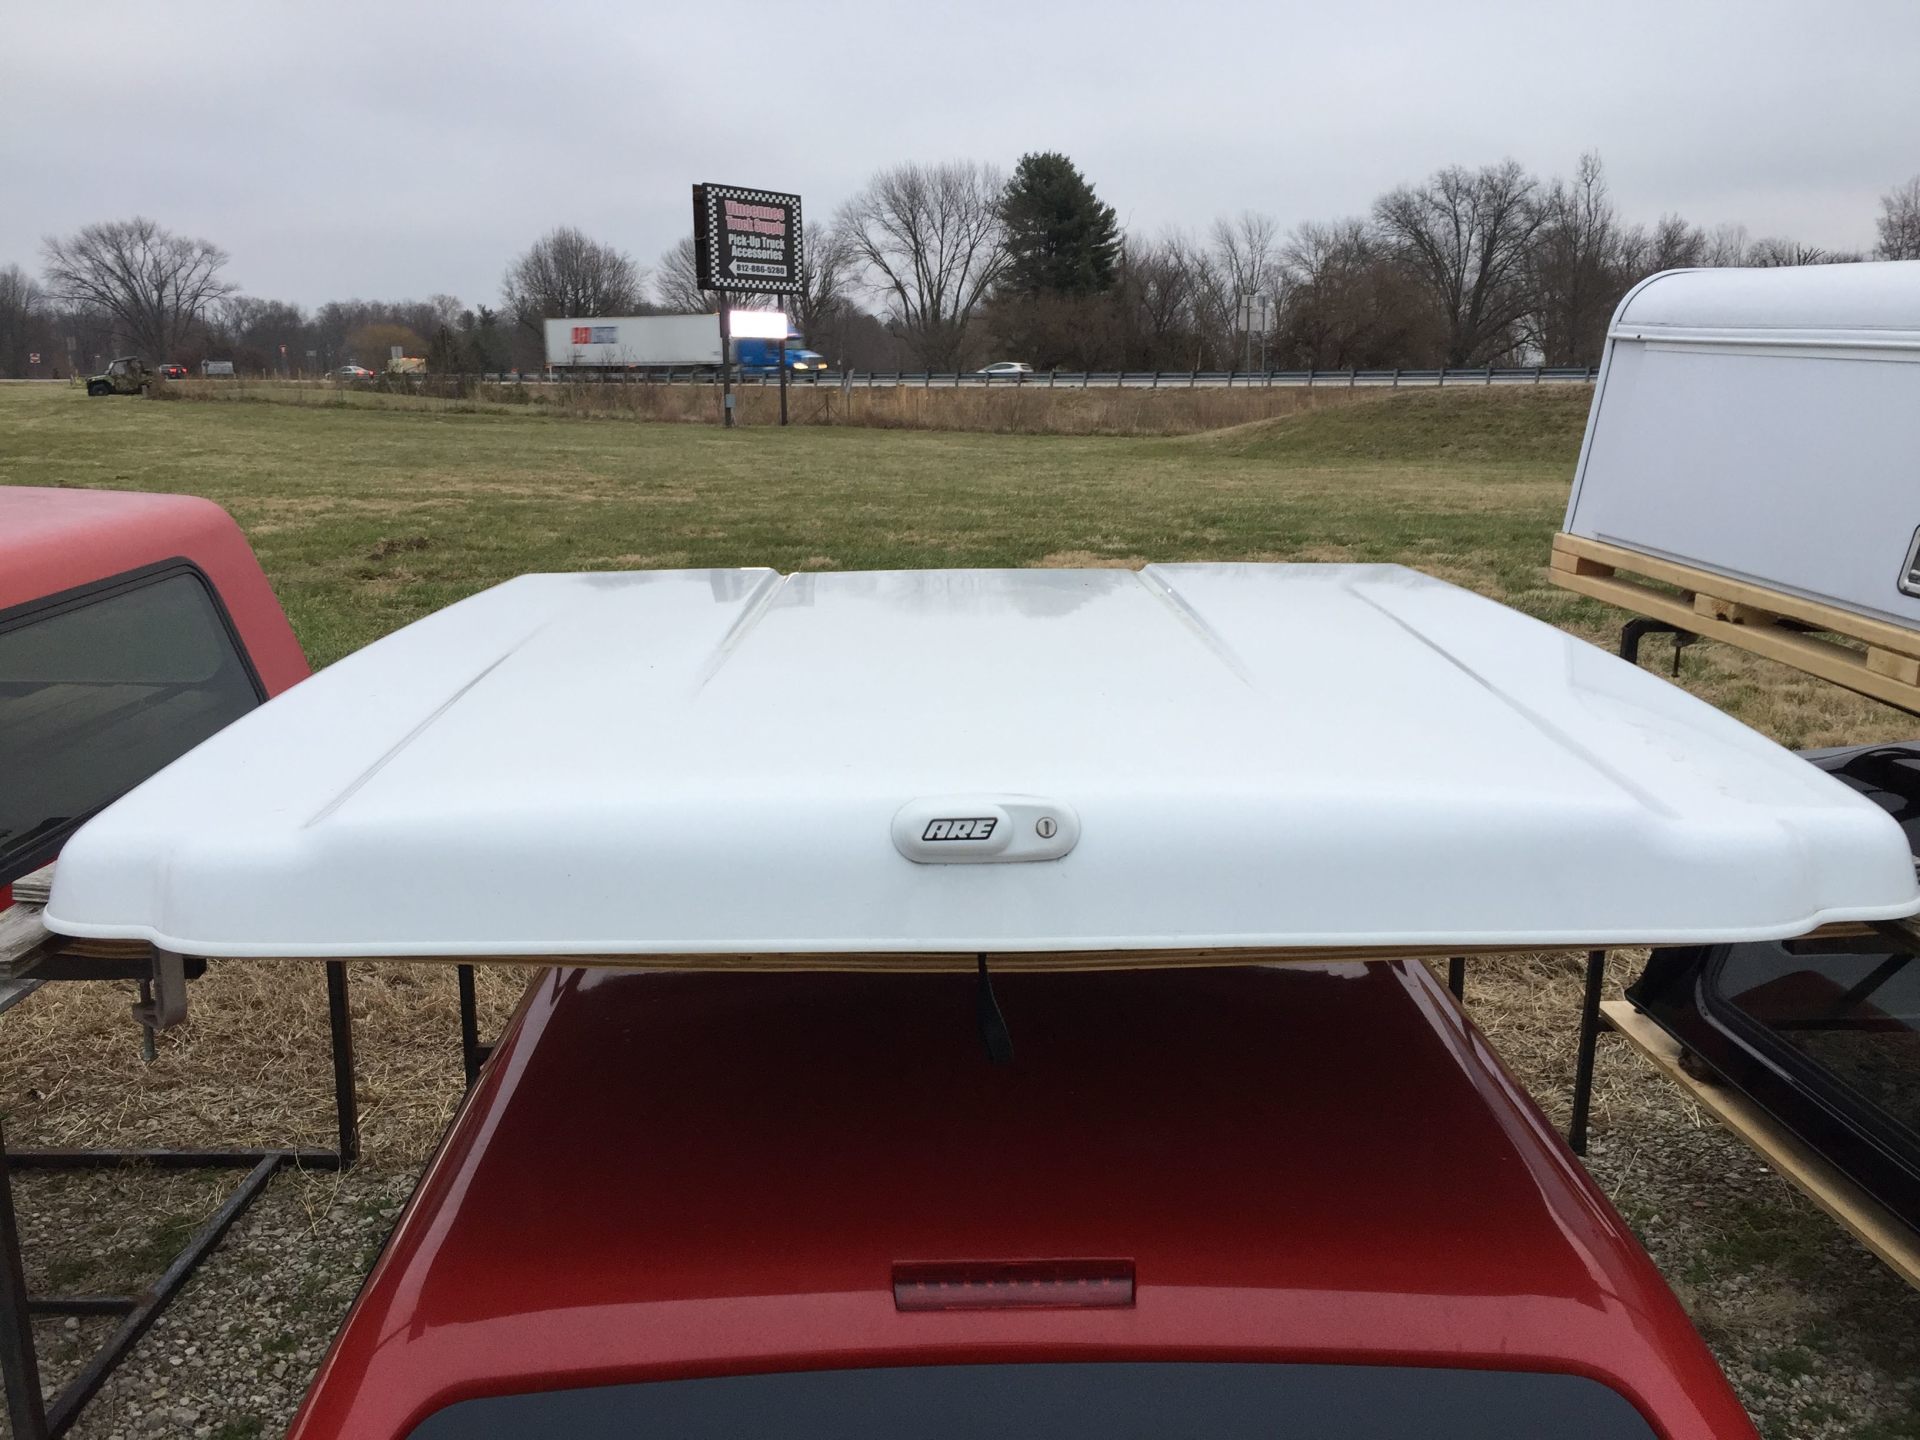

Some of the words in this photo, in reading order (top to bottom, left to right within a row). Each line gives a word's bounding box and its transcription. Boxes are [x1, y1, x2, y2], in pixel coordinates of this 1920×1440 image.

[728, 233, 760, 248] Pick-Up
[761, 236, 785, 250] Truck
[731, 245, 783, 260] Accessories
[923, 818, 997, 840] ARE
